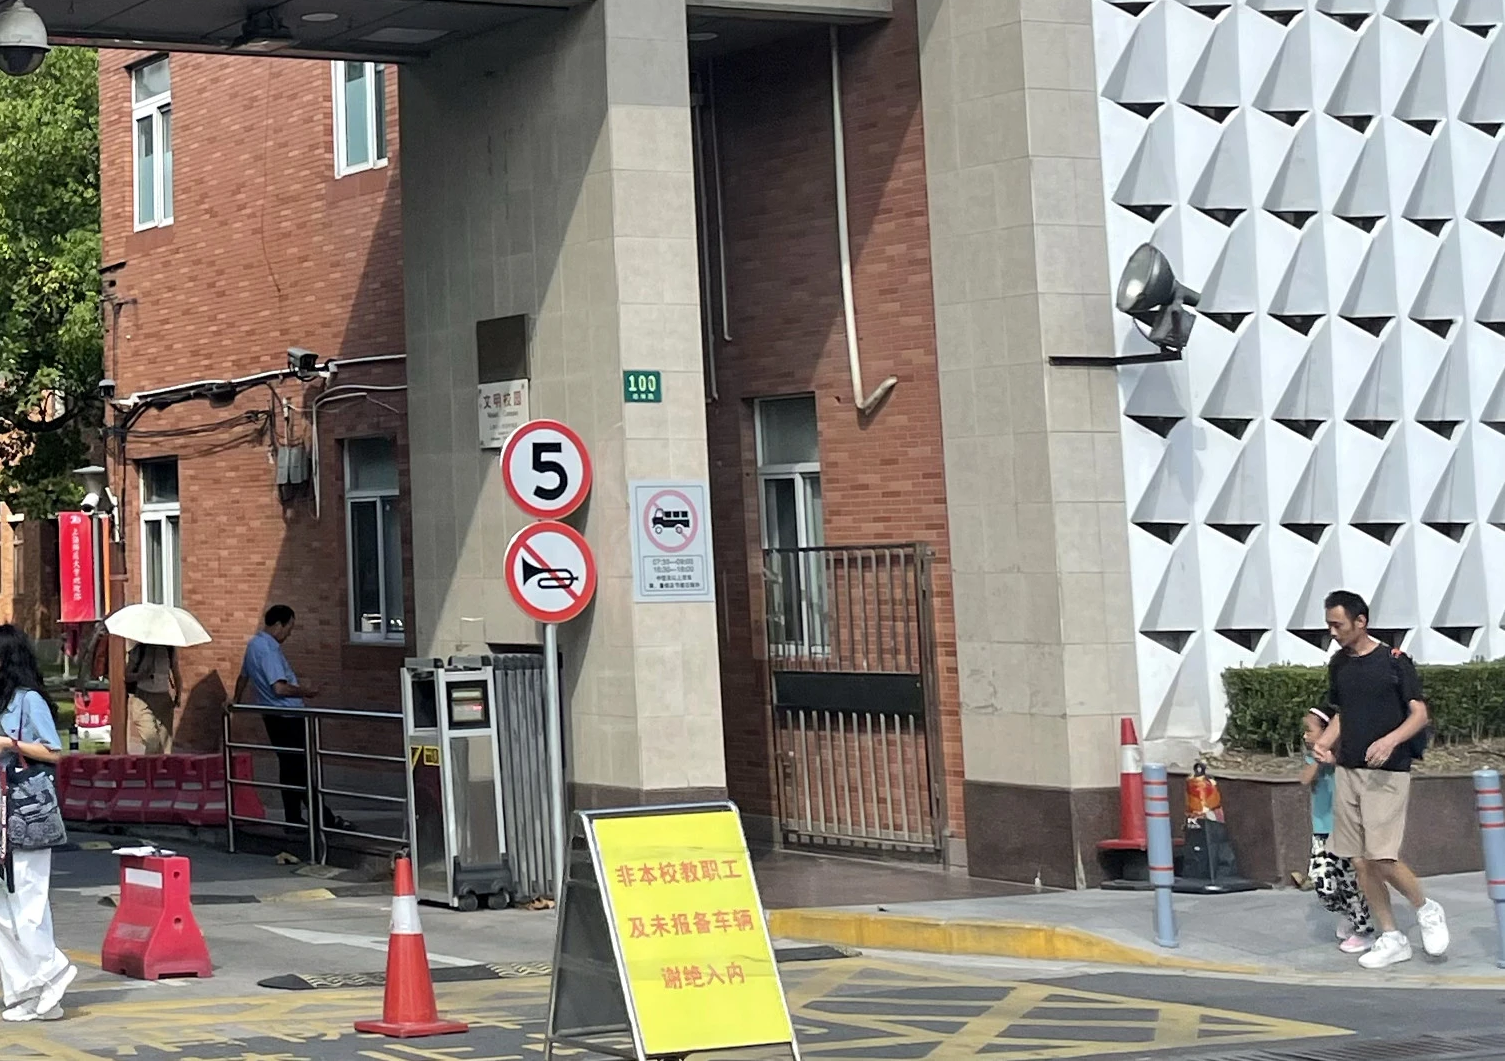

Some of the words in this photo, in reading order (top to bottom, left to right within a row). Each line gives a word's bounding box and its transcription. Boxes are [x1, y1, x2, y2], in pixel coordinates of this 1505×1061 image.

[628, 375, 656, 392] 100
[532, 442, 568, 501] 5
[615, 859, 743, 888] 非本校教职工
[628, 909, 755, 939] 及未报备车辆
[661, 962, 746, 990] 谢绝入内
